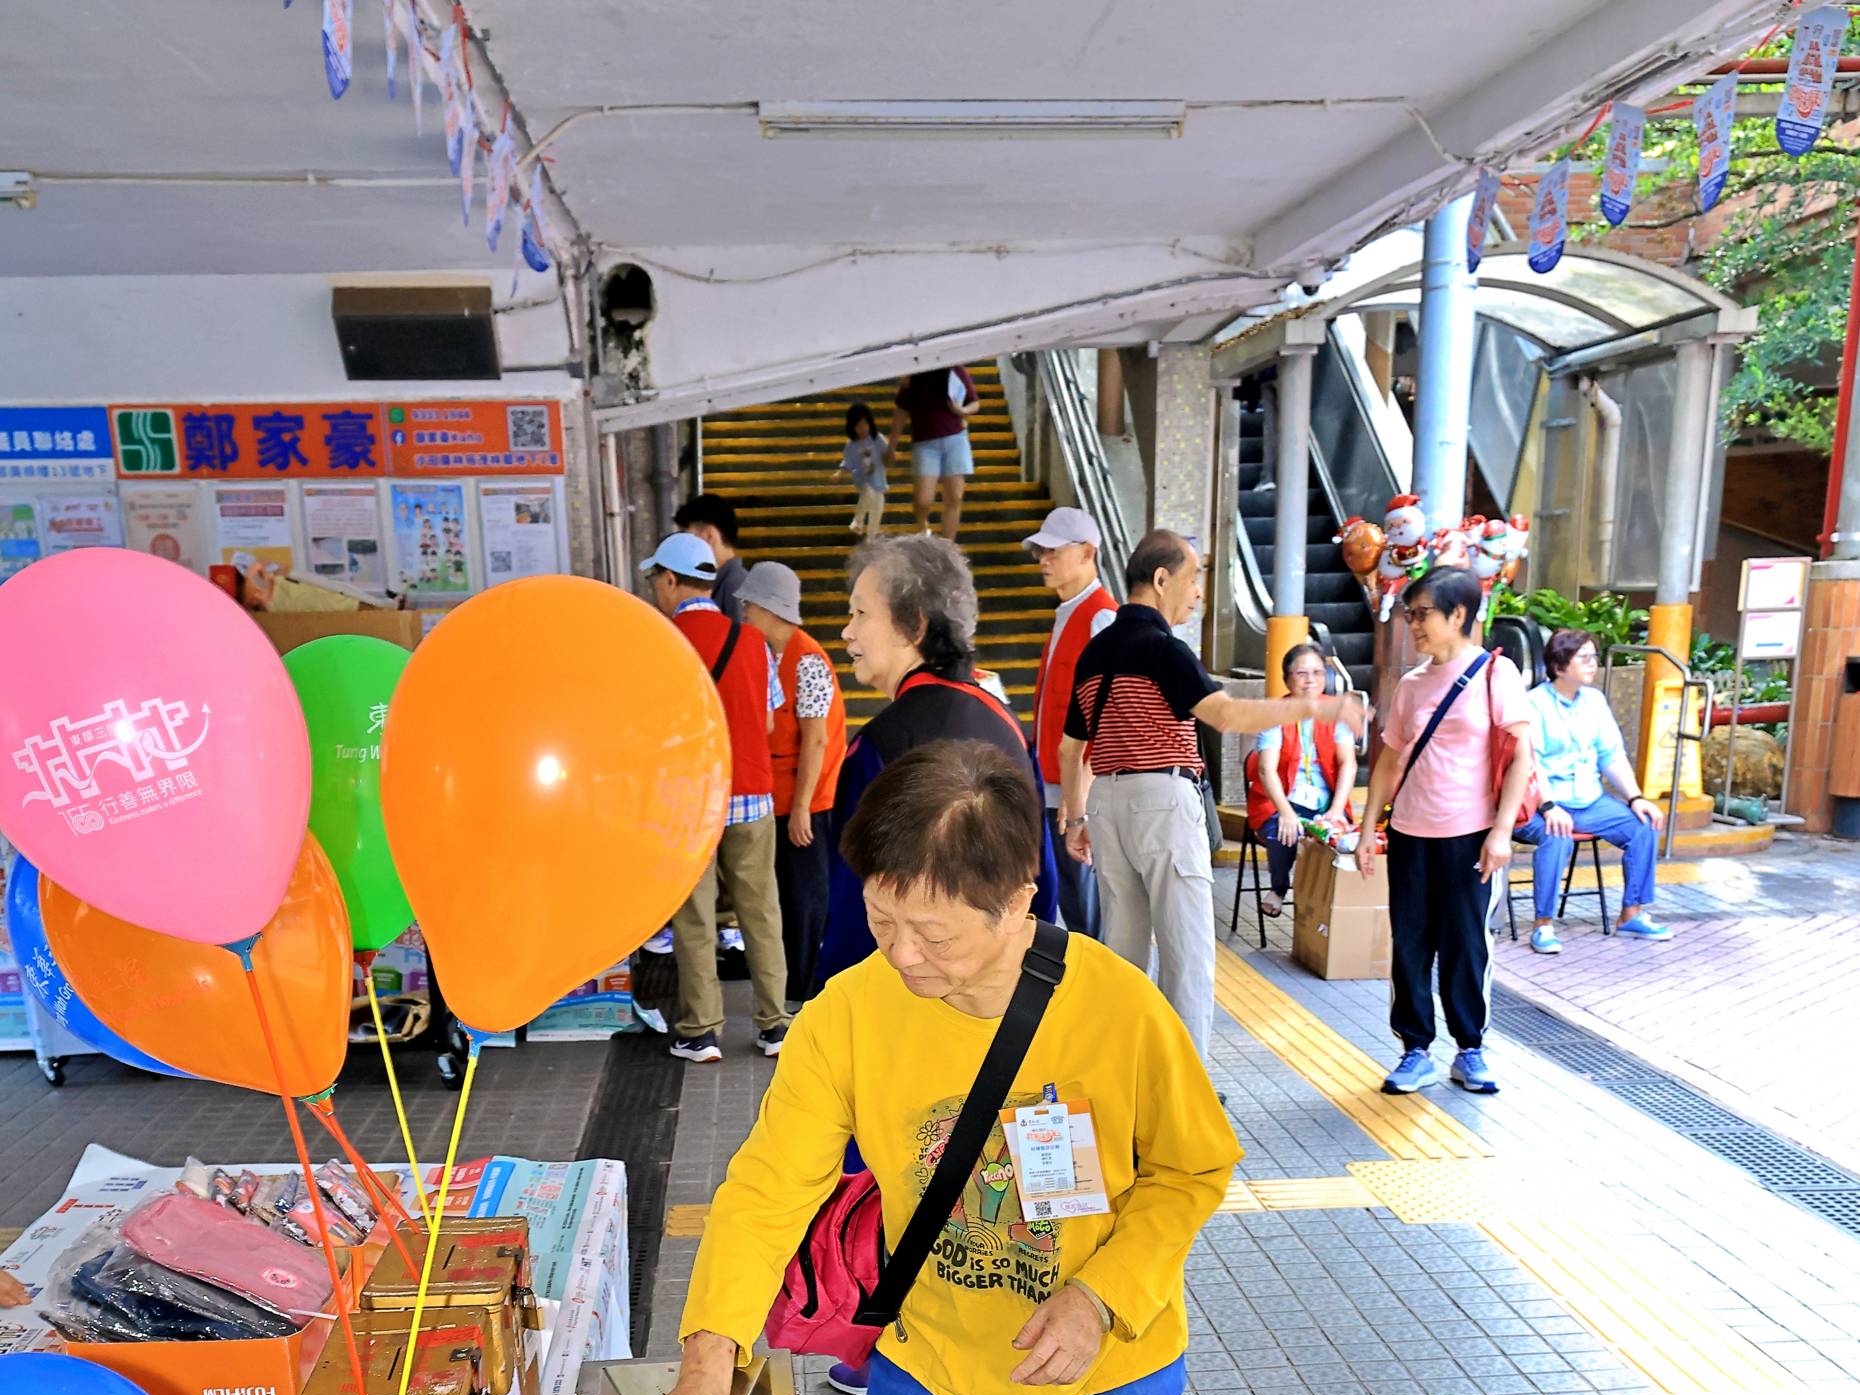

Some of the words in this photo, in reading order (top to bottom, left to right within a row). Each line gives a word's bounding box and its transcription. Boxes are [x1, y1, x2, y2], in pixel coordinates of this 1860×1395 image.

[182, 411, 376, 472] 鄭家豪
[99, 771, 199, 818] 行善無界限
[992, 1258, 1010, 1270] SO
[1016, 1260, 1060, 1288] MUCH
